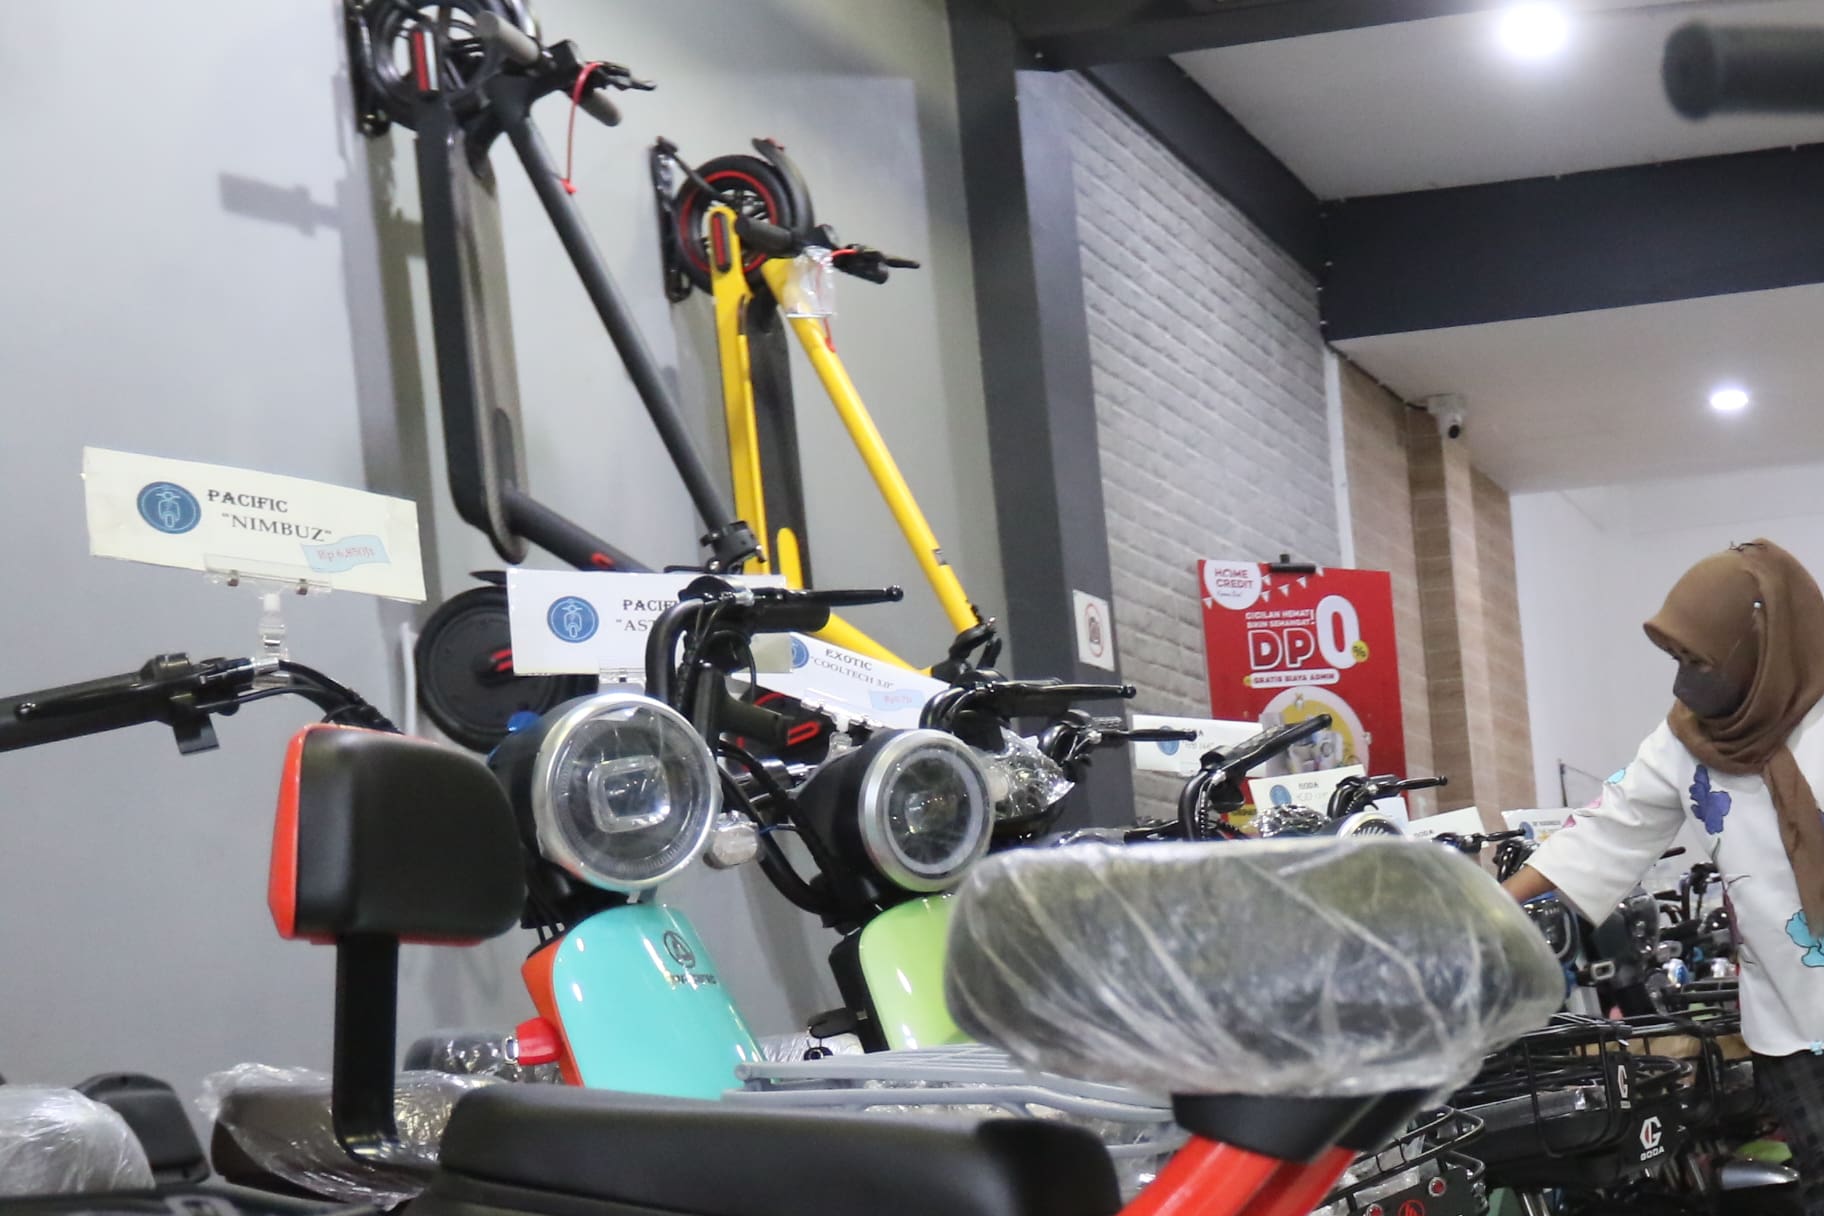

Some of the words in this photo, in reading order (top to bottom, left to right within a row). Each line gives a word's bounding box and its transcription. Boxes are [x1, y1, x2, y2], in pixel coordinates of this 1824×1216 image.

[207, 489, 289, 514] PACIFIC
[221, 511, 333, 542] "NIMBUZ"
[1214, 568, 1249, 579] HOME
[1216, 578, 1254, 589] CREDIT
[623, 599, 679, 611] PACIF
[826, 648, 872, 671] EXOTIC
[1640, 1146, 1665, 1161] GODA
